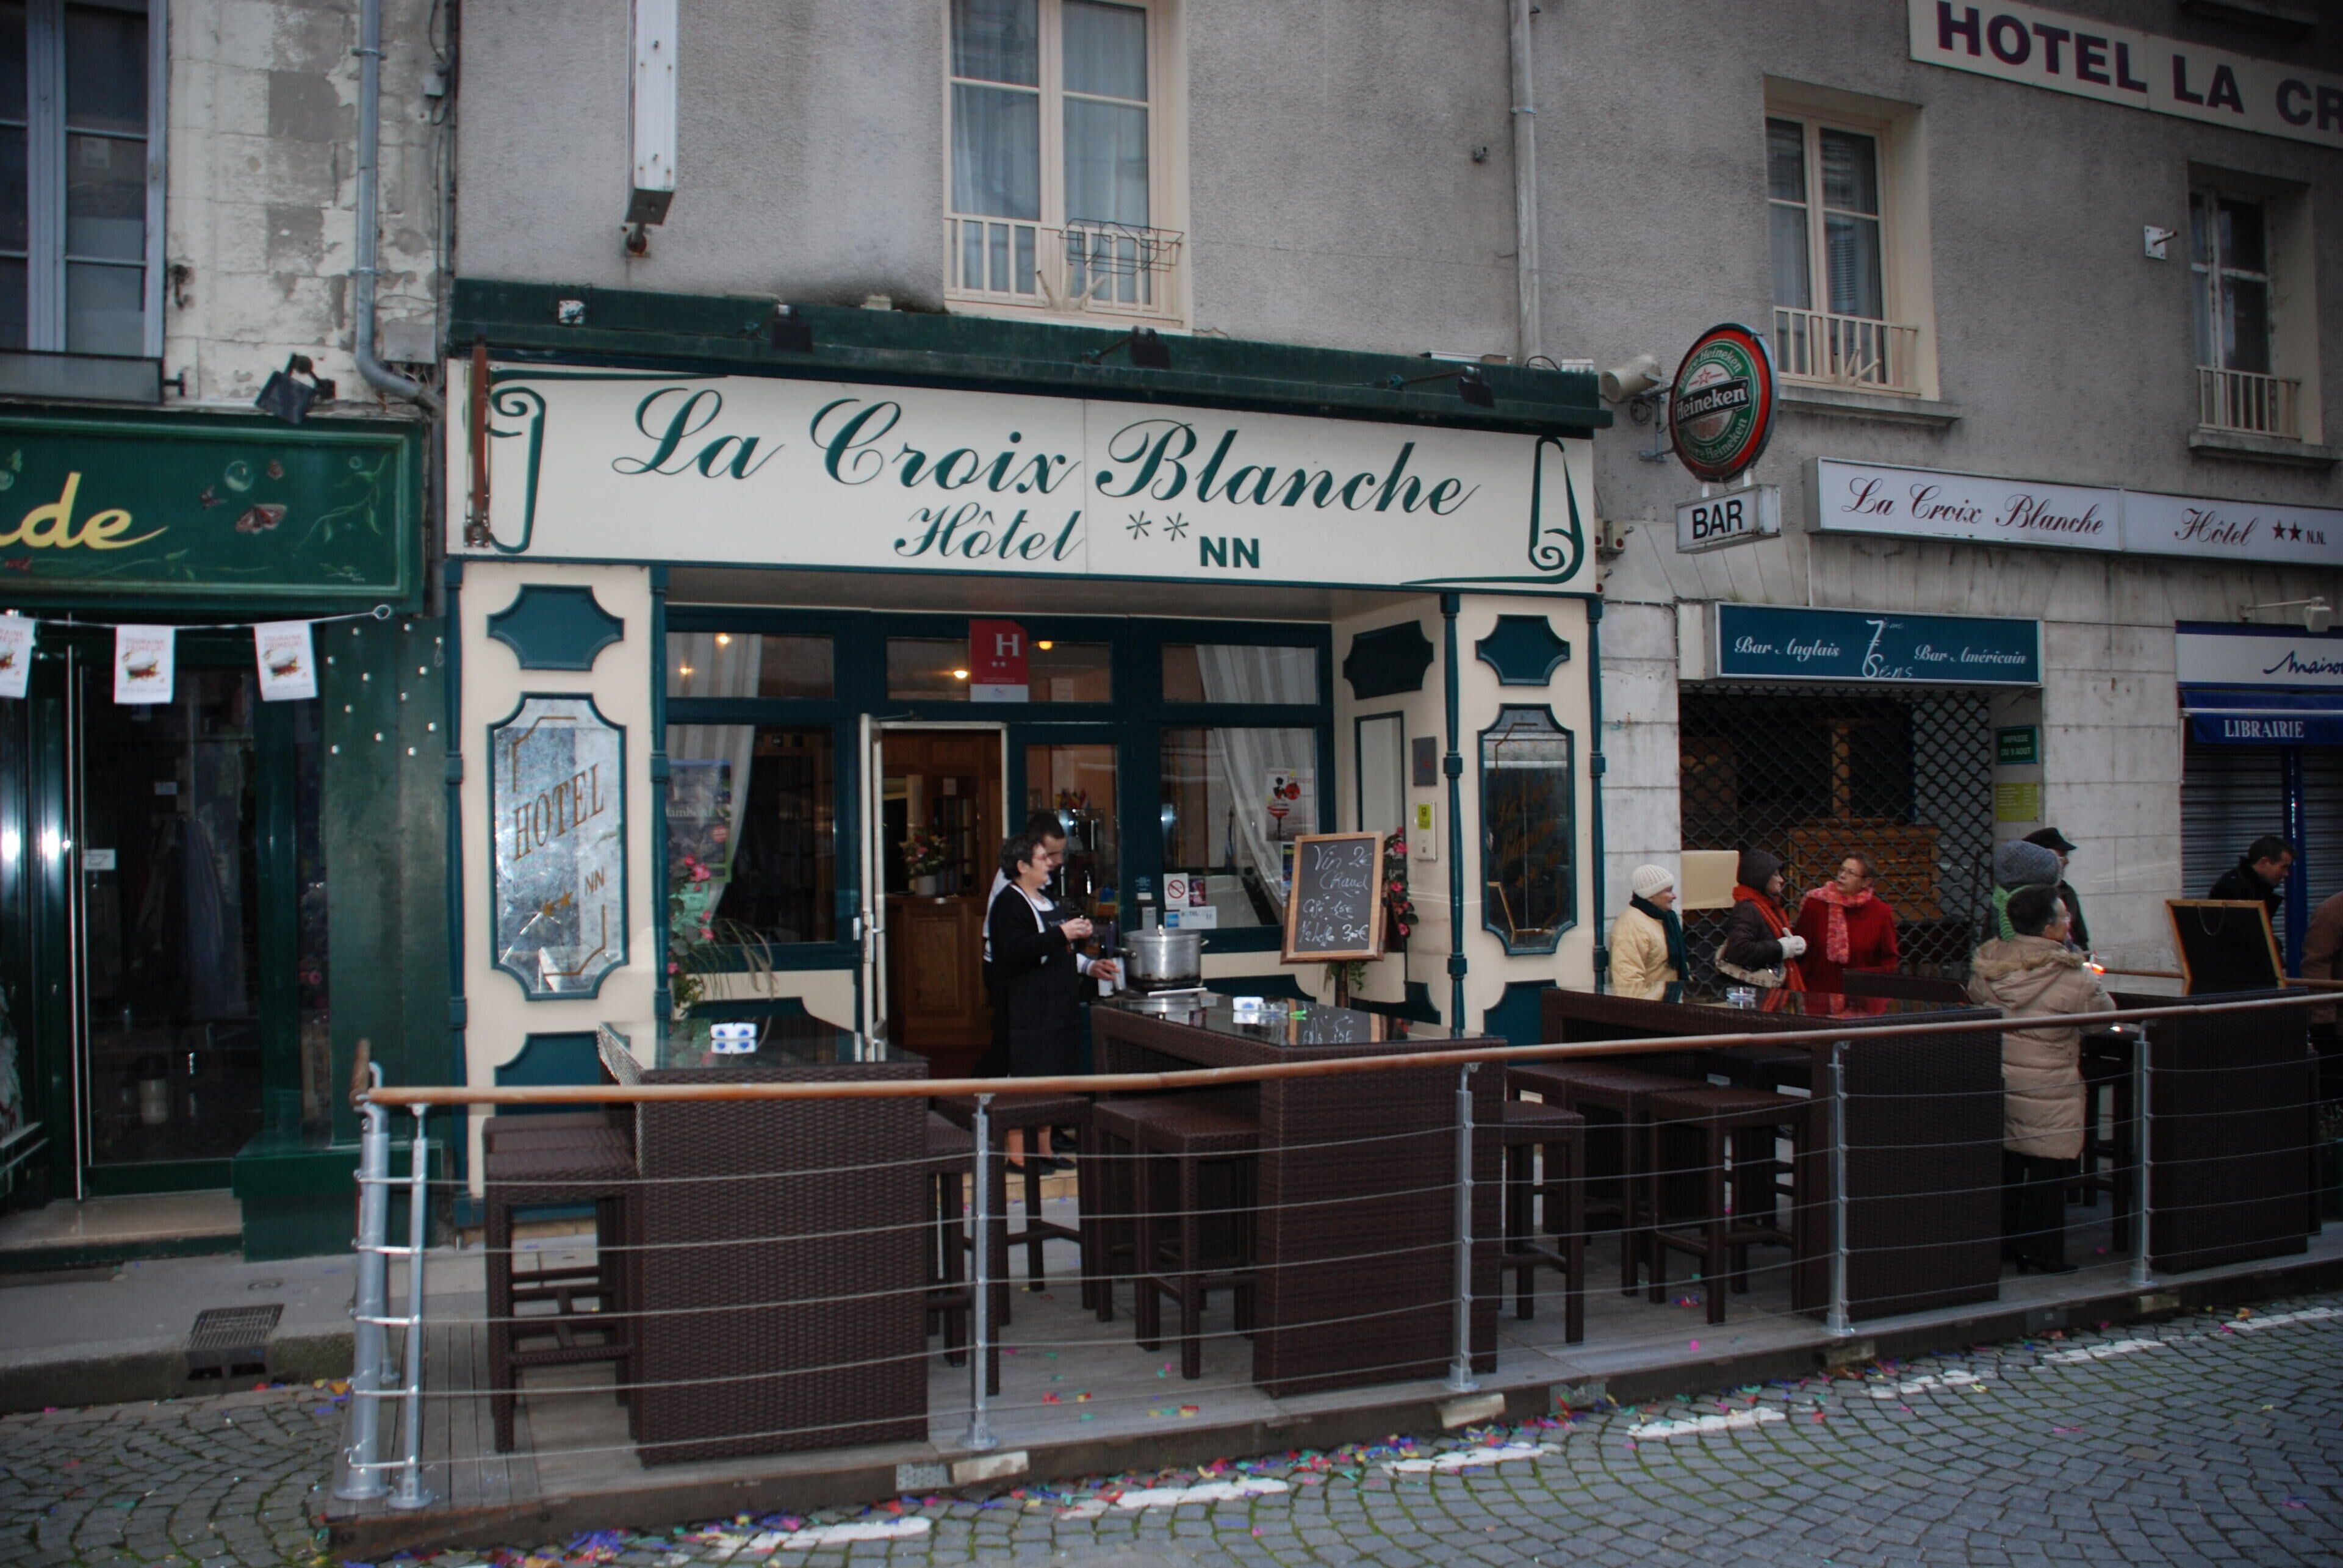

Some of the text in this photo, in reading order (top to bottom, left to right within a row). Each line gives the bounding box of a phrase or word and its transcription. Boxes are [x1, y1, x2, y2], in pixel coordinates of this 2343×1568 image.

[1937, 1, 2147, 94] HOTEL
[2172, 54, 2245, 114] LA
[1676, 384, 1747, 420] Heineken
[611, 387, 1481, 516] La Croix Blanche
[1692, 499, 1743, 540] BAR
[1841, 477, 2105, 534] La Croix Blanche
[894, 501, 1261, 569] Hôtel NN
[2175, 508, 2327, 547] Hôtel N.N.
[995, 633, 1020, 656] H
[1734, 635, 1841, 663] Bar Anglais
[1914, 644, 2028, 666] Bar Américain
[2224, 719, 2305, 738] LIBRAIRIE
[1314, 845, 1342, 871] Vin
[585, 866, 605, 897] NN
